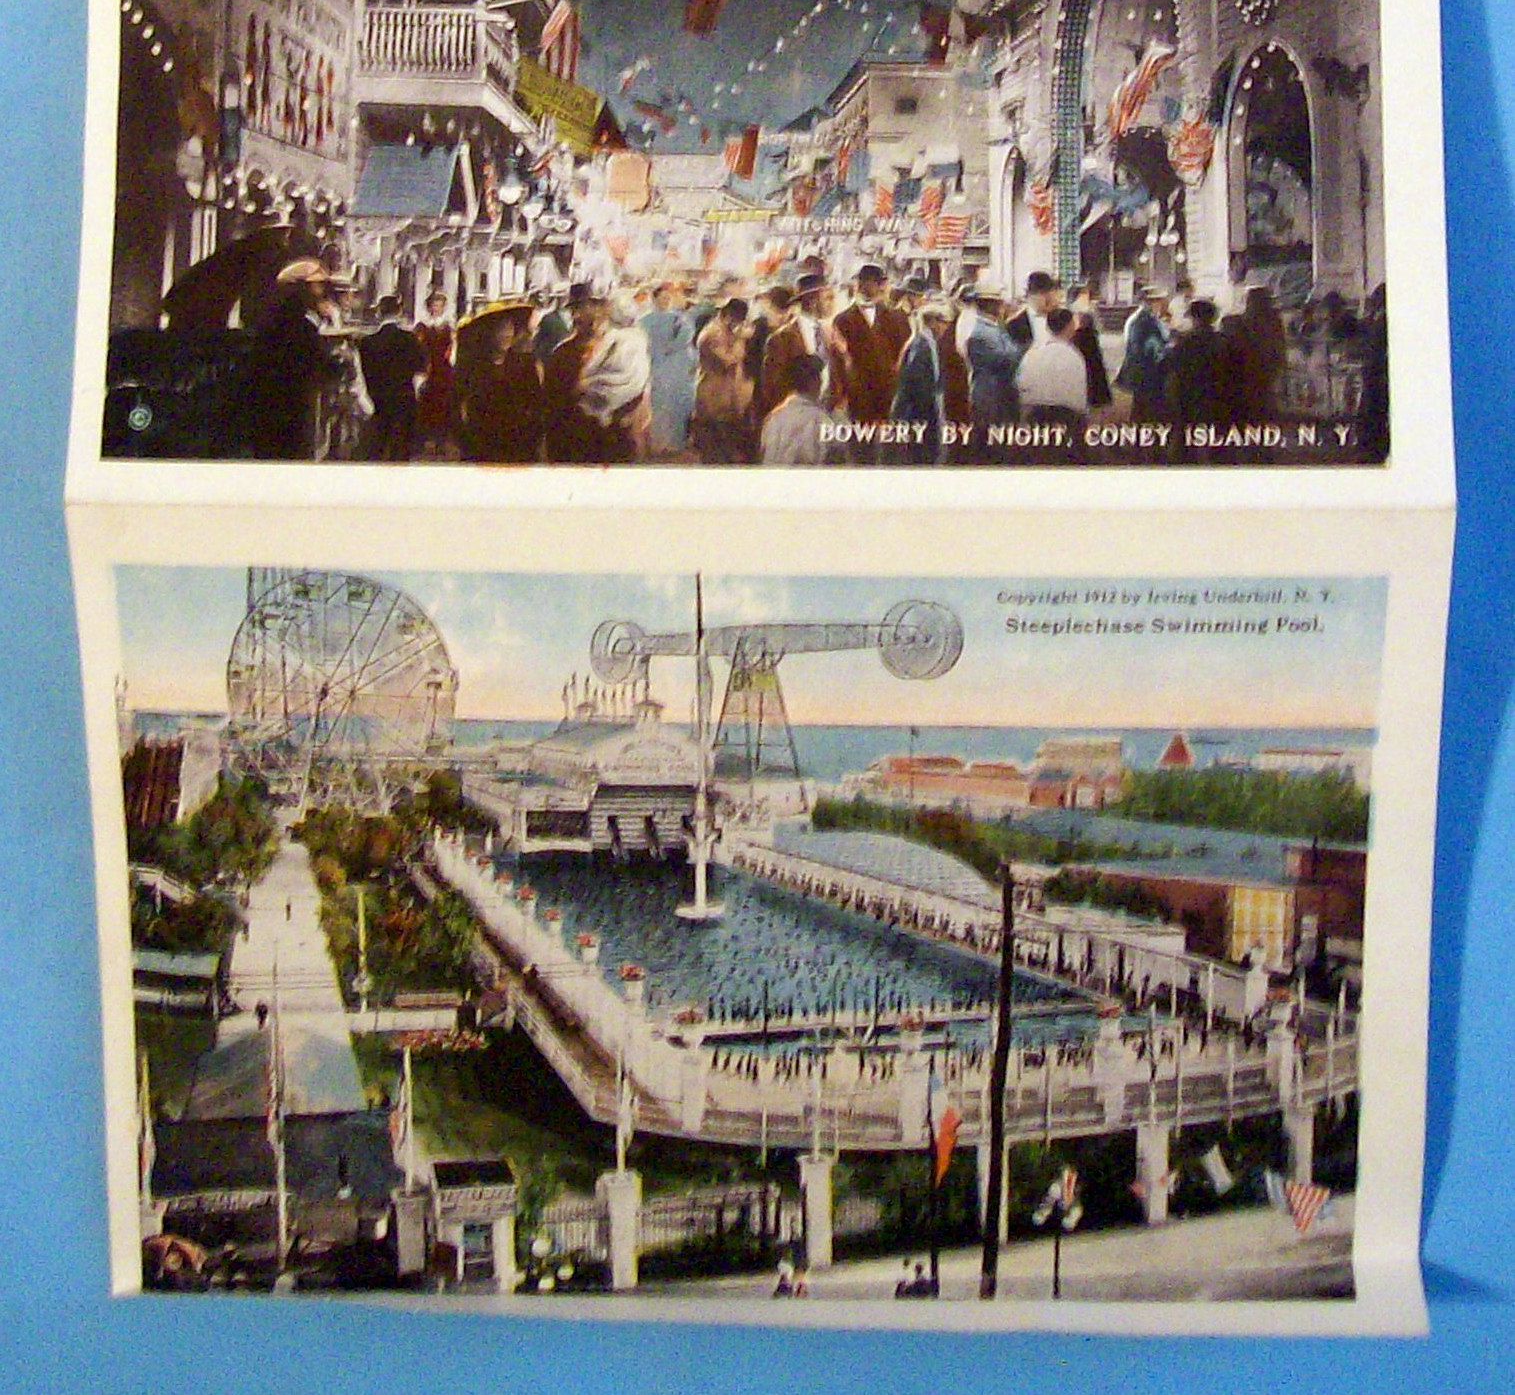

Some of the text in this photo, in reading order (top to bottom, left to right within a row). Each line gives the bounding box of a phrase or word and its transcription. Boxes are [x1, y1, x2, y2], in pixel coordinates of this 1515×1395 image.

[819, 423, 927, 444] BOWERY
[941, 423, 972, 444] BY
[986, 423, 1073, 447] NIGHT,
[1083, 423, 1173, 445] CONEY
[1184, 424, 1288, 447] ISLAND,
[1297, 425, 1323, 445] N.
[997, 590, 1077, 606] Copyright
[1085, 590, 1116, 604] 1912
[1121, 590, 1140, 606] by
[1148, 590, 1197, 606] Irving
[1006, 615, 1325, 635] Steeplechase Swimming Pool.
